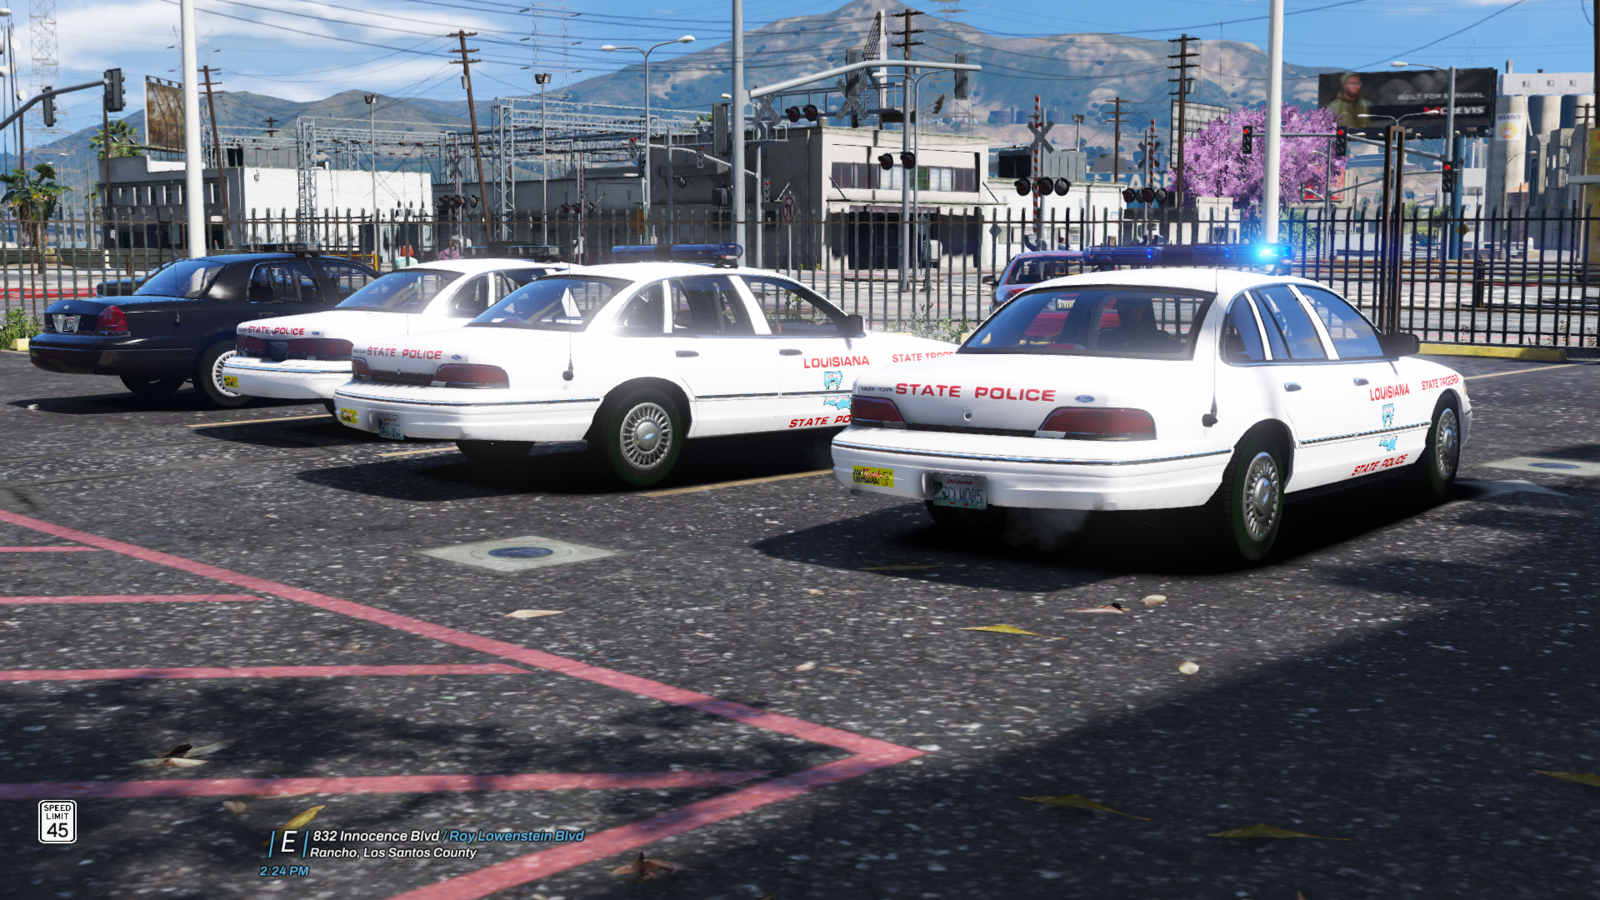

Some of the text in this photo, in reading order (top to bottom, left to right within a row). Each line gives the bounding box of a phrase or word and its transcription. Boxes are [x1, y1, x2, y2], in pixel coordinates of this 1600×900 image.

[1397, 93, 1421, 101] BUILT
[1443, 92, 1485, 100] SRVIVAL
[248, 325, 270, 334] STATE
[274, 326, 305, 336] POLICE
[367, 345, 397, 357] STATE
[402, 348, 442, 360] POLICE
[892, 352, 922, 363] STATE
[803, 355, 870, 370] LOUISIANA
[1421, 377, 1438, 391] STATE
[895, 382, 962, 398] STATE
[975, 386, 1057, 403] POLICE
[1369, 382, 1410, 402] LOUISIANA
[789, 415, 830, 429] STATE
[1351, 454, 1409, 477] STATE POLICE
